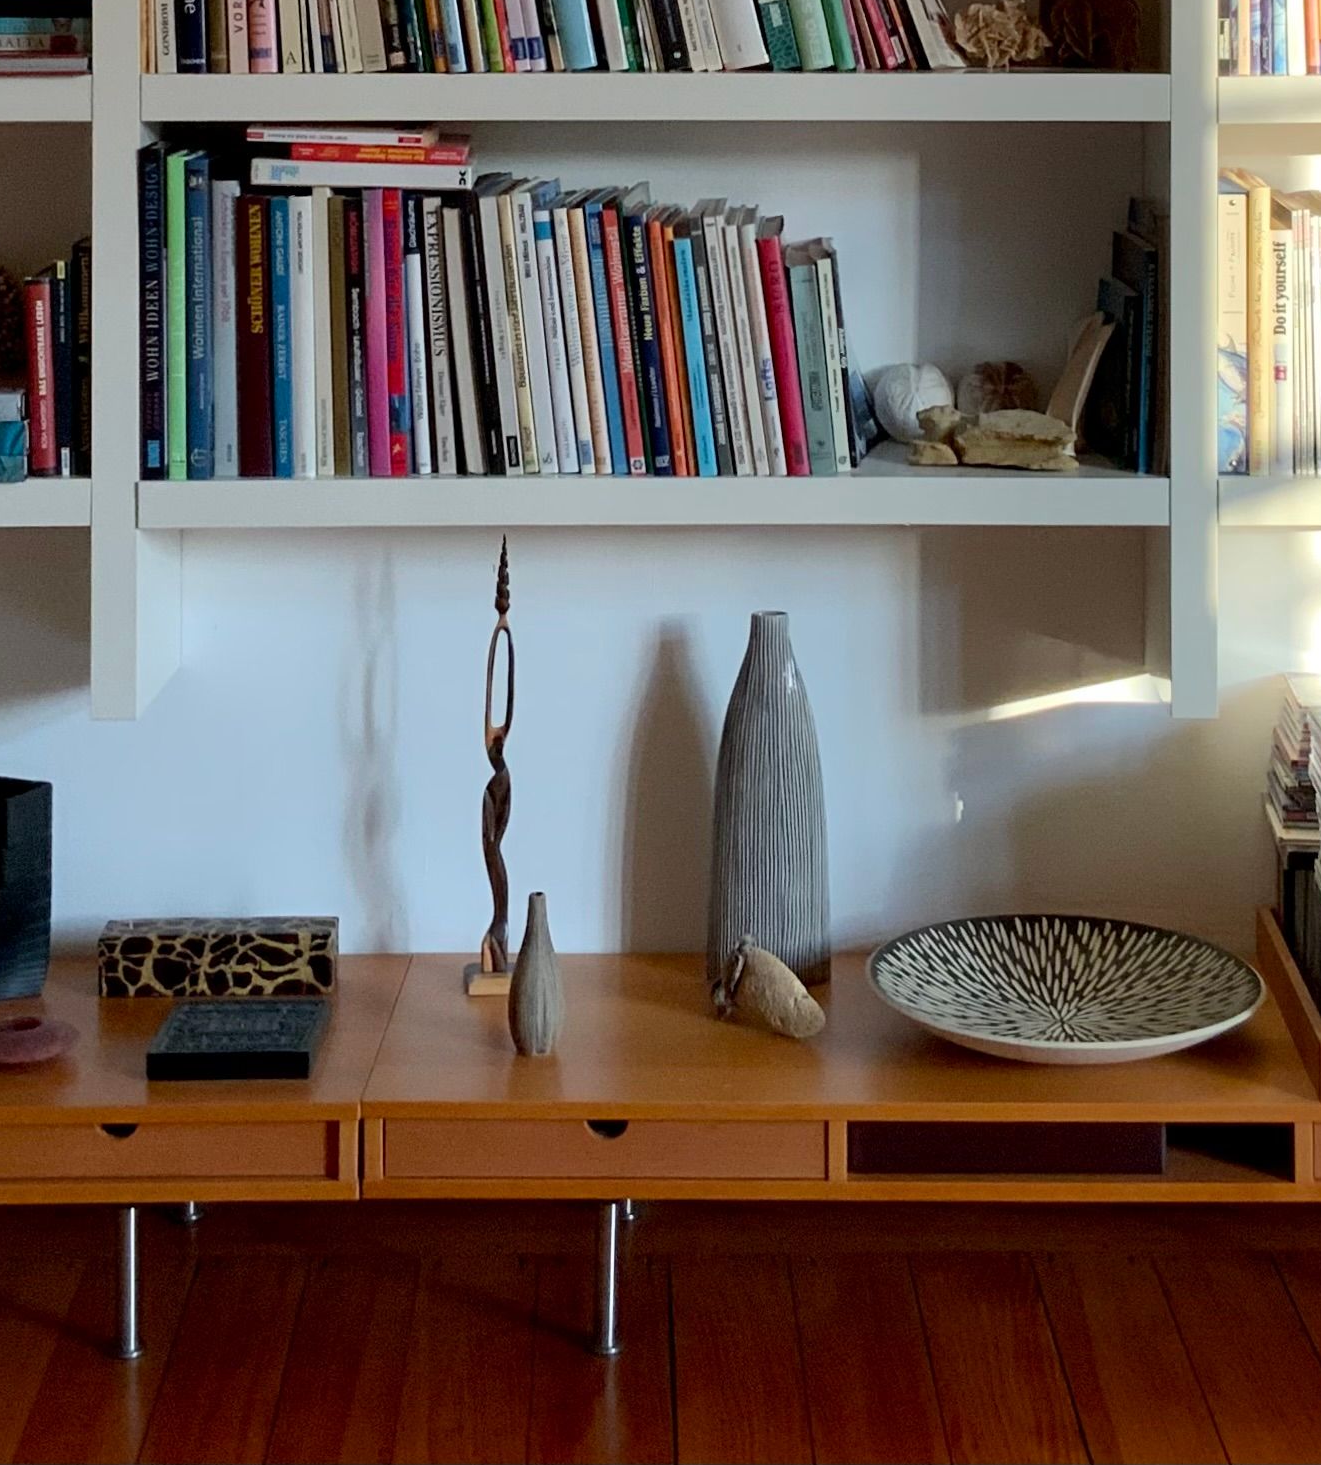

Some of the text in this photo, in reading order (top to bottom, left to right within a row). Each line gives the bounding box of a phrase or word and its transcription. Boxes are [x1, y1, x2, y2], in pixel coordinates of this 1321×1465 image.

[274, 210, 285, 245] ANTONI
[406, 200, 418, 248] Dachräume
[632, 226, 646, 263] Effekte
[191, 216, 205, 360] Wohnen International
[247, 204, 265, 334] SCHÖNER WOHNEN
[425, 209, 445, 357] EXPRESSIONISMUS
[1273, 241, 1289, 302] yourself
[350, 287, 361, 329] Sembach
[607, 226, 634, 375] Mediterraner Wohnstil
[638, 277, 651, 312] Farben
[276, 304, 286, 341] RAINER
[641, 315, 654, 341] Neue
[1272, 316, 1287, 336] Do
[759, 358, 775, 403] Lofts
[278, 419, 289, 464] TASCHEN
